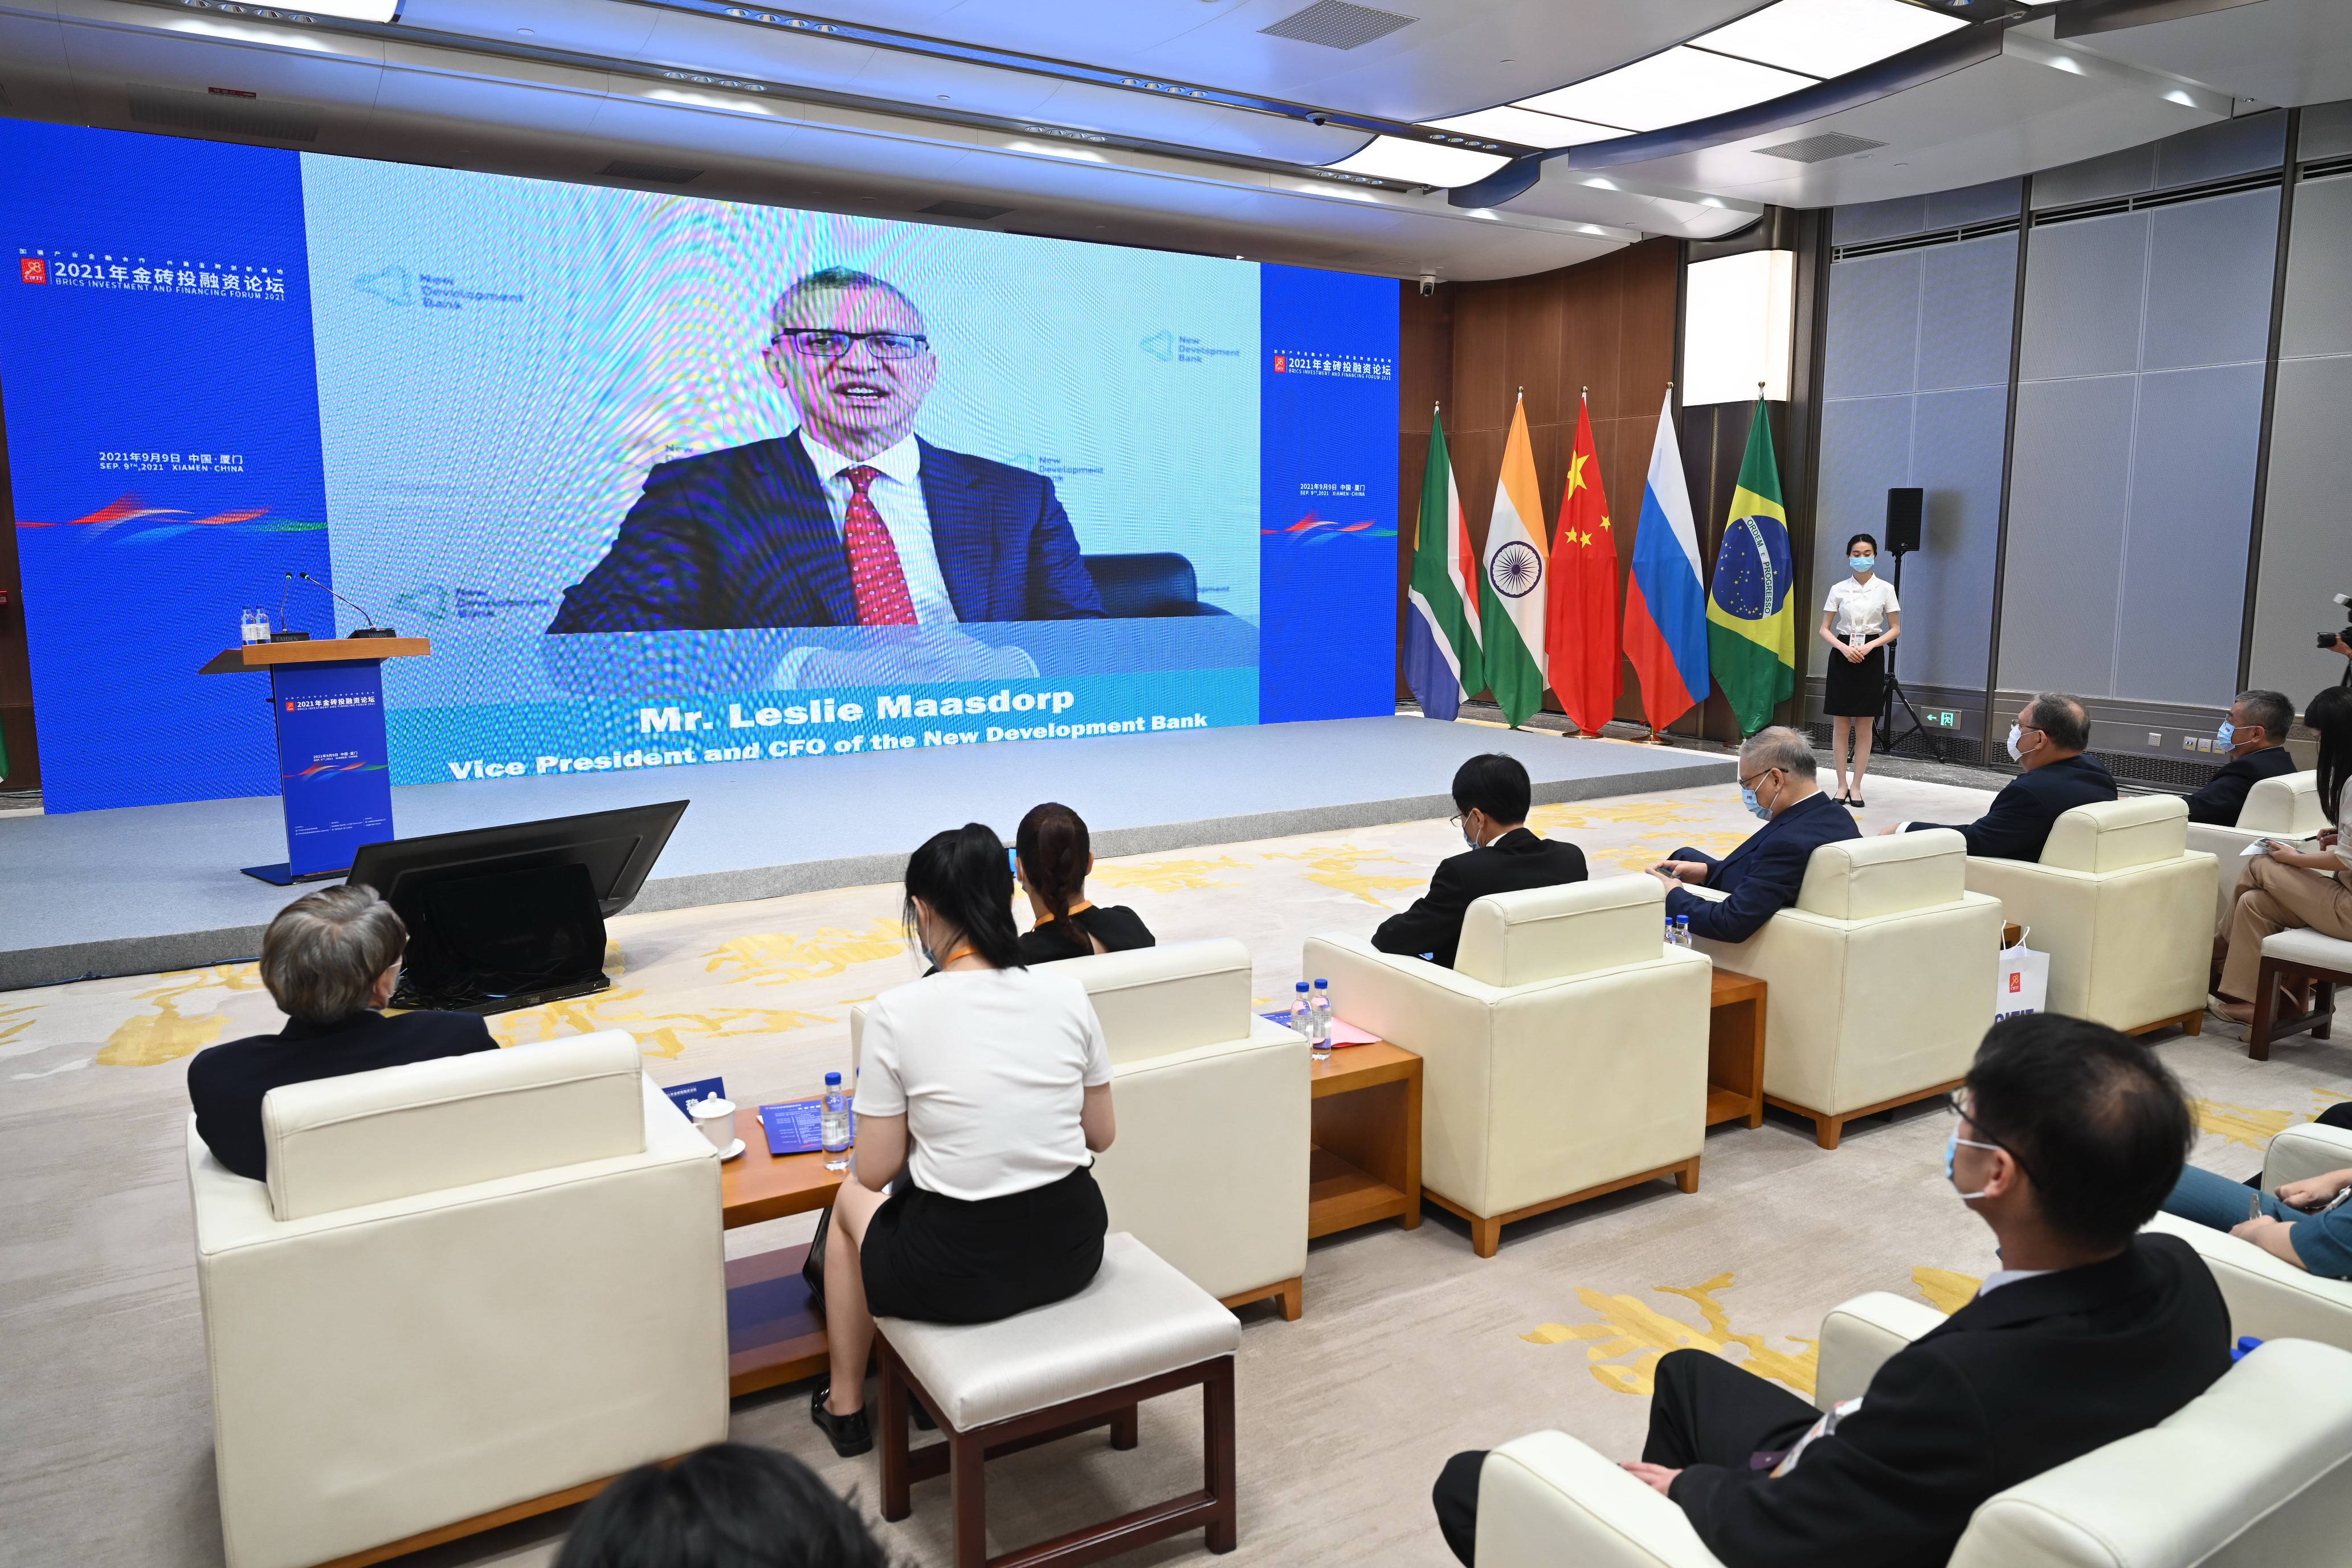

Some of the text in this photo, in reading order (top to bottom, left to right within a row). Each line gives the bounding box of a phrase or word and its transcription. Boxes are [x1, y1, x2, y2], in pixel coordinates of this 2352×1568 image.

[55, 262, 284, 293] 2021年金砖投融资论坛
[56, 278, 84, 287] BRICS
[88, 280, 149, 291] INVESTMENT
[175, 286, 226, 297] FINANCING
[230, 290, 261, 299] FORUM
[1179, 336, 1199, 344] New
[1179, 345, 1240, 356] Development
[1288, 358, 1391, 375] 2021年金砖投融资论坛
[99, 452, 243, 464] 2021年9月9日 中国·厦门
[1039, 466, 1104, 474] Development
[1747, 519, 1764, 548] ORDEM
[1763, 561, 1772, 614] PROGRESSO
[297, 696, 375, 708] 2021年金砖投融资论坛
[640, 689, 1075, 733] Mr. Leslie Maasdorp
[448, 713, 1208, 779] Vice President and CFO of the New Development Bank
